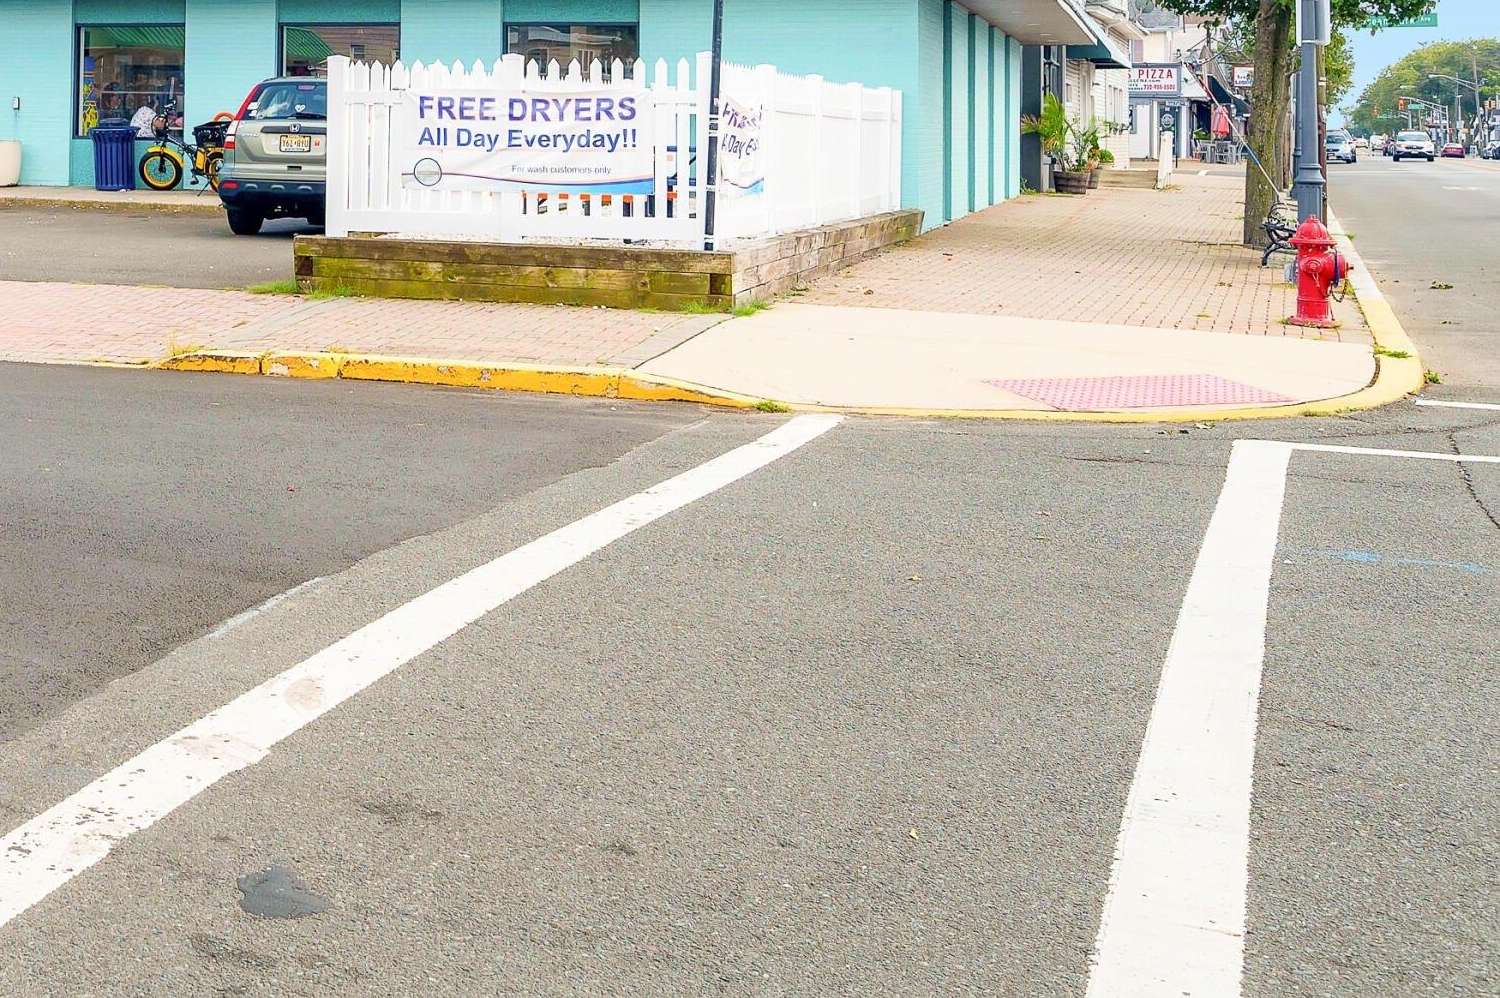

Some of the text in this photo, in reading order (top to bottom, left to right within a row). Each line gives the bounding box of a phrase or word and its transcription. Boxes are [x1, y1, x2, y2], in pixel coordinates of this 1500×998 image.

[1138, 69, 1173, 79] PIZZA
[419, 95, 637, 122] FREE DRYERS
[418, 126, 637, 153] All Day Everyday!!
[511, 164, 611, 175] For wash customers only
